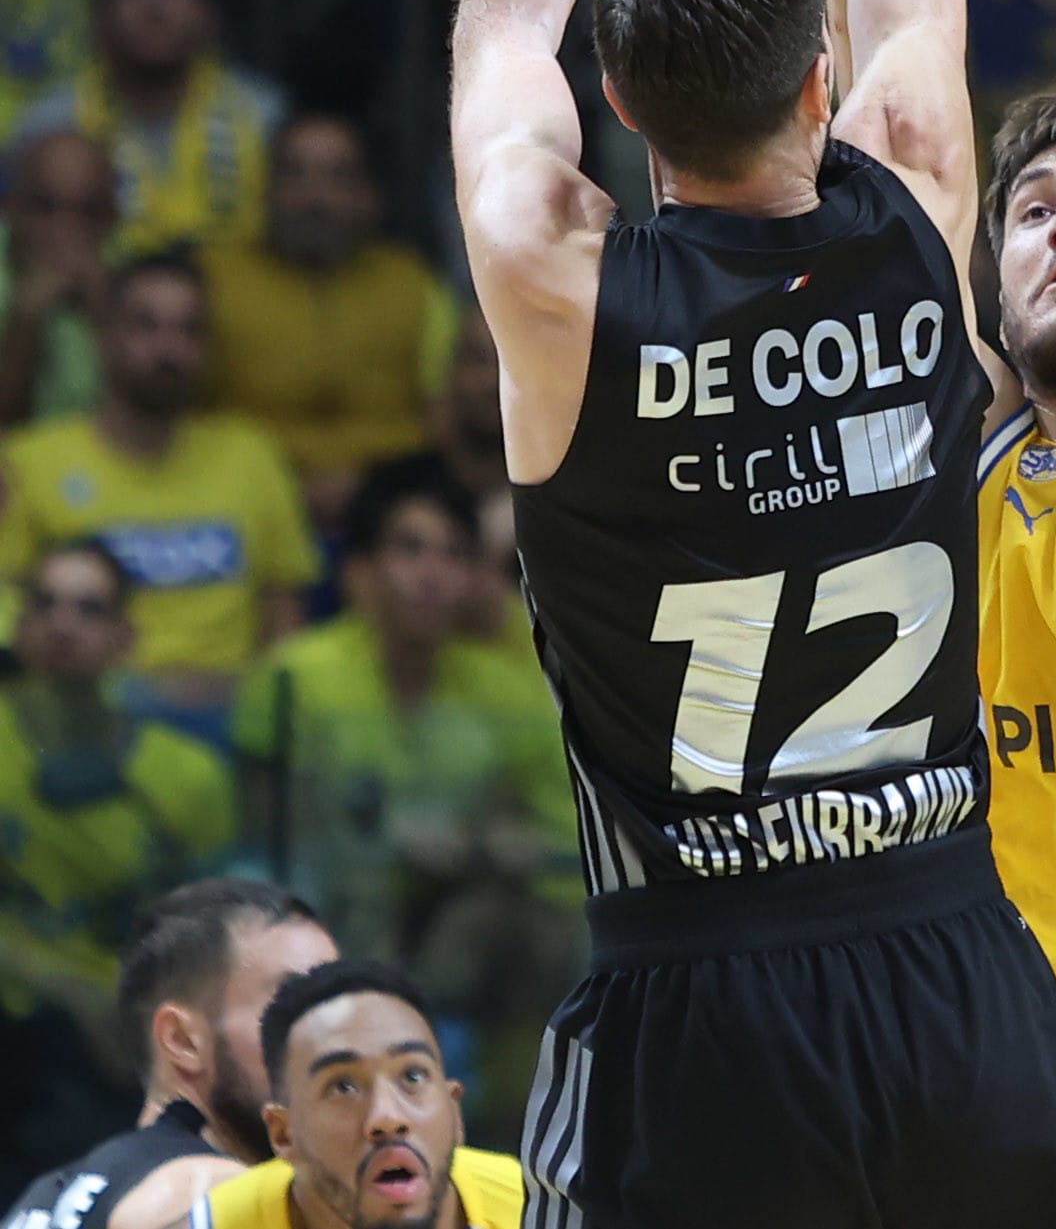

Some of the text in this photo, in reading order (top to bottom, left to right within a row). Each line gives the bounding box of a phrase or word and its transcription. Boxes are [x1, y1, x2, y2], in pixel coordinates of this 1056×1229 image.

[637, 299, 944, 419] DE COLO
[668, 425, 839, 492] ciril
[748, 478, 841, 515] GROUP
[649, 541, 955, 797] 12
